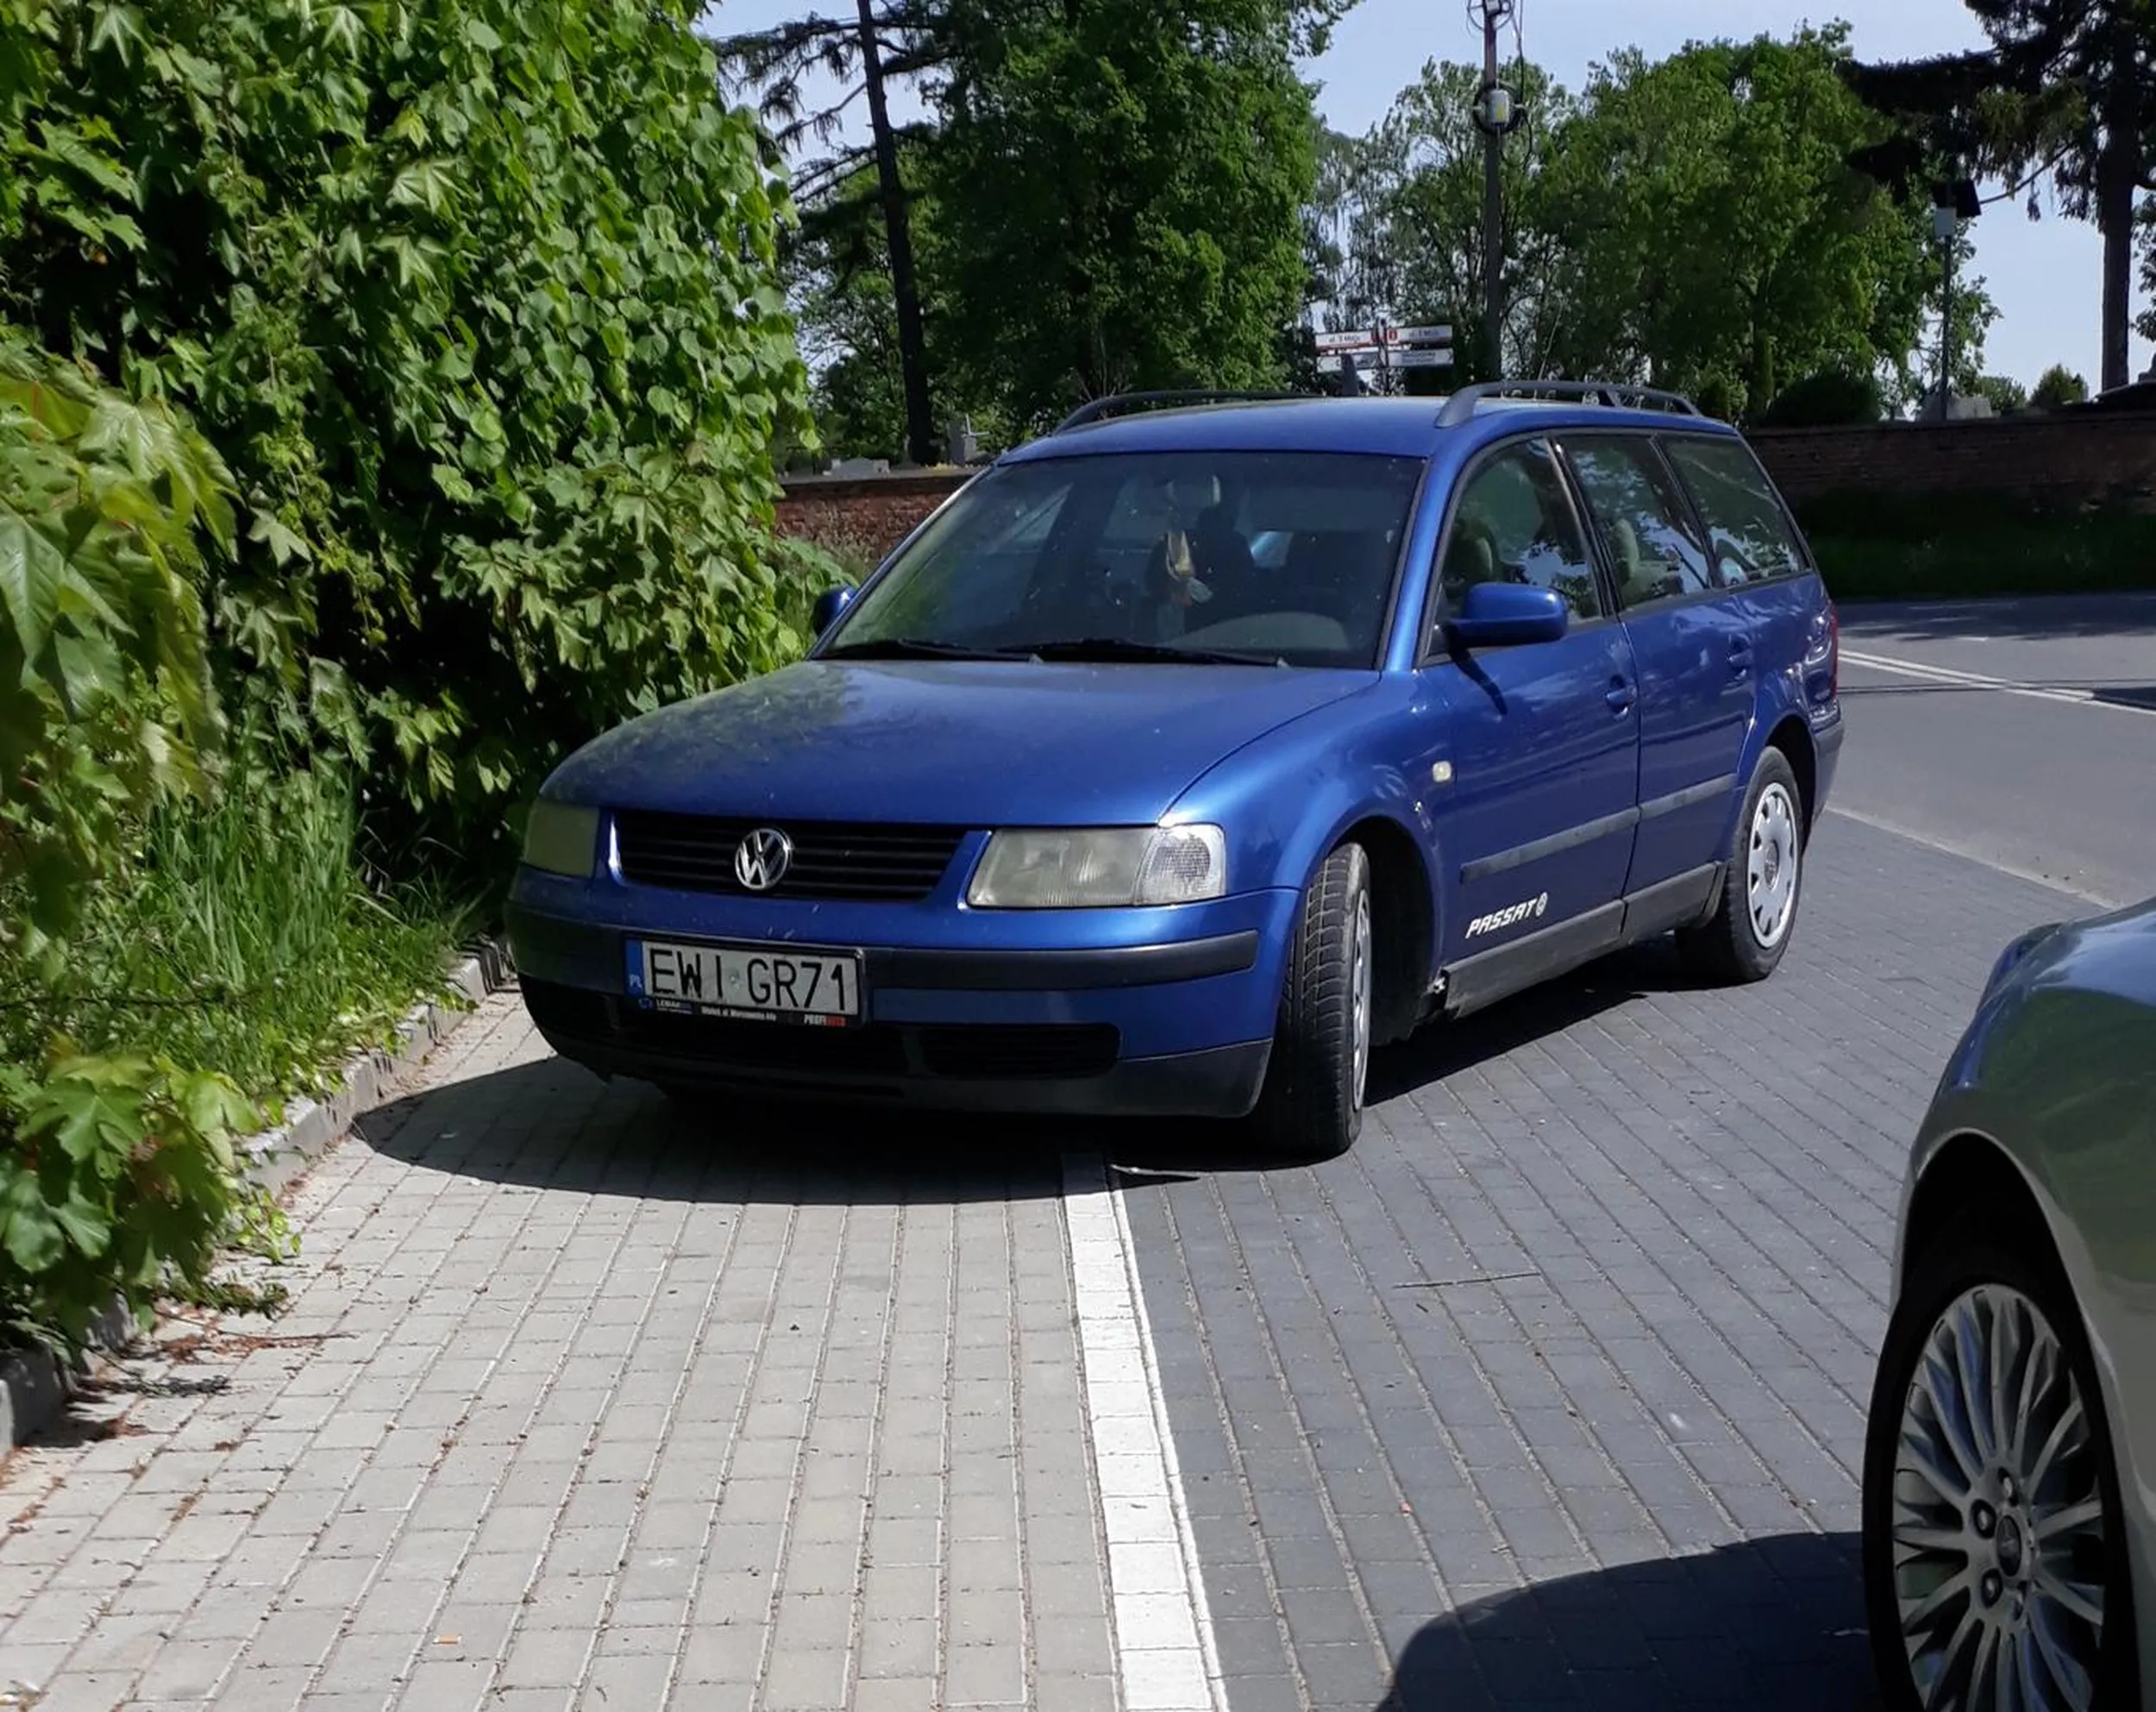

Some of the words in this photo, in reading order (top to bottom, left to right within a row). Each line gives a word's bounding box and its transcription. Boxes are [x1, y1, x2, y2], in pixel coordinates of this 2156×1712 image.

[1465, 898, 1538, 939] PASSAT
[629, 974, 642, 989] PL
[649, 949, 724, 1000] EWI
[747, 958, 845, 1011] GR71
